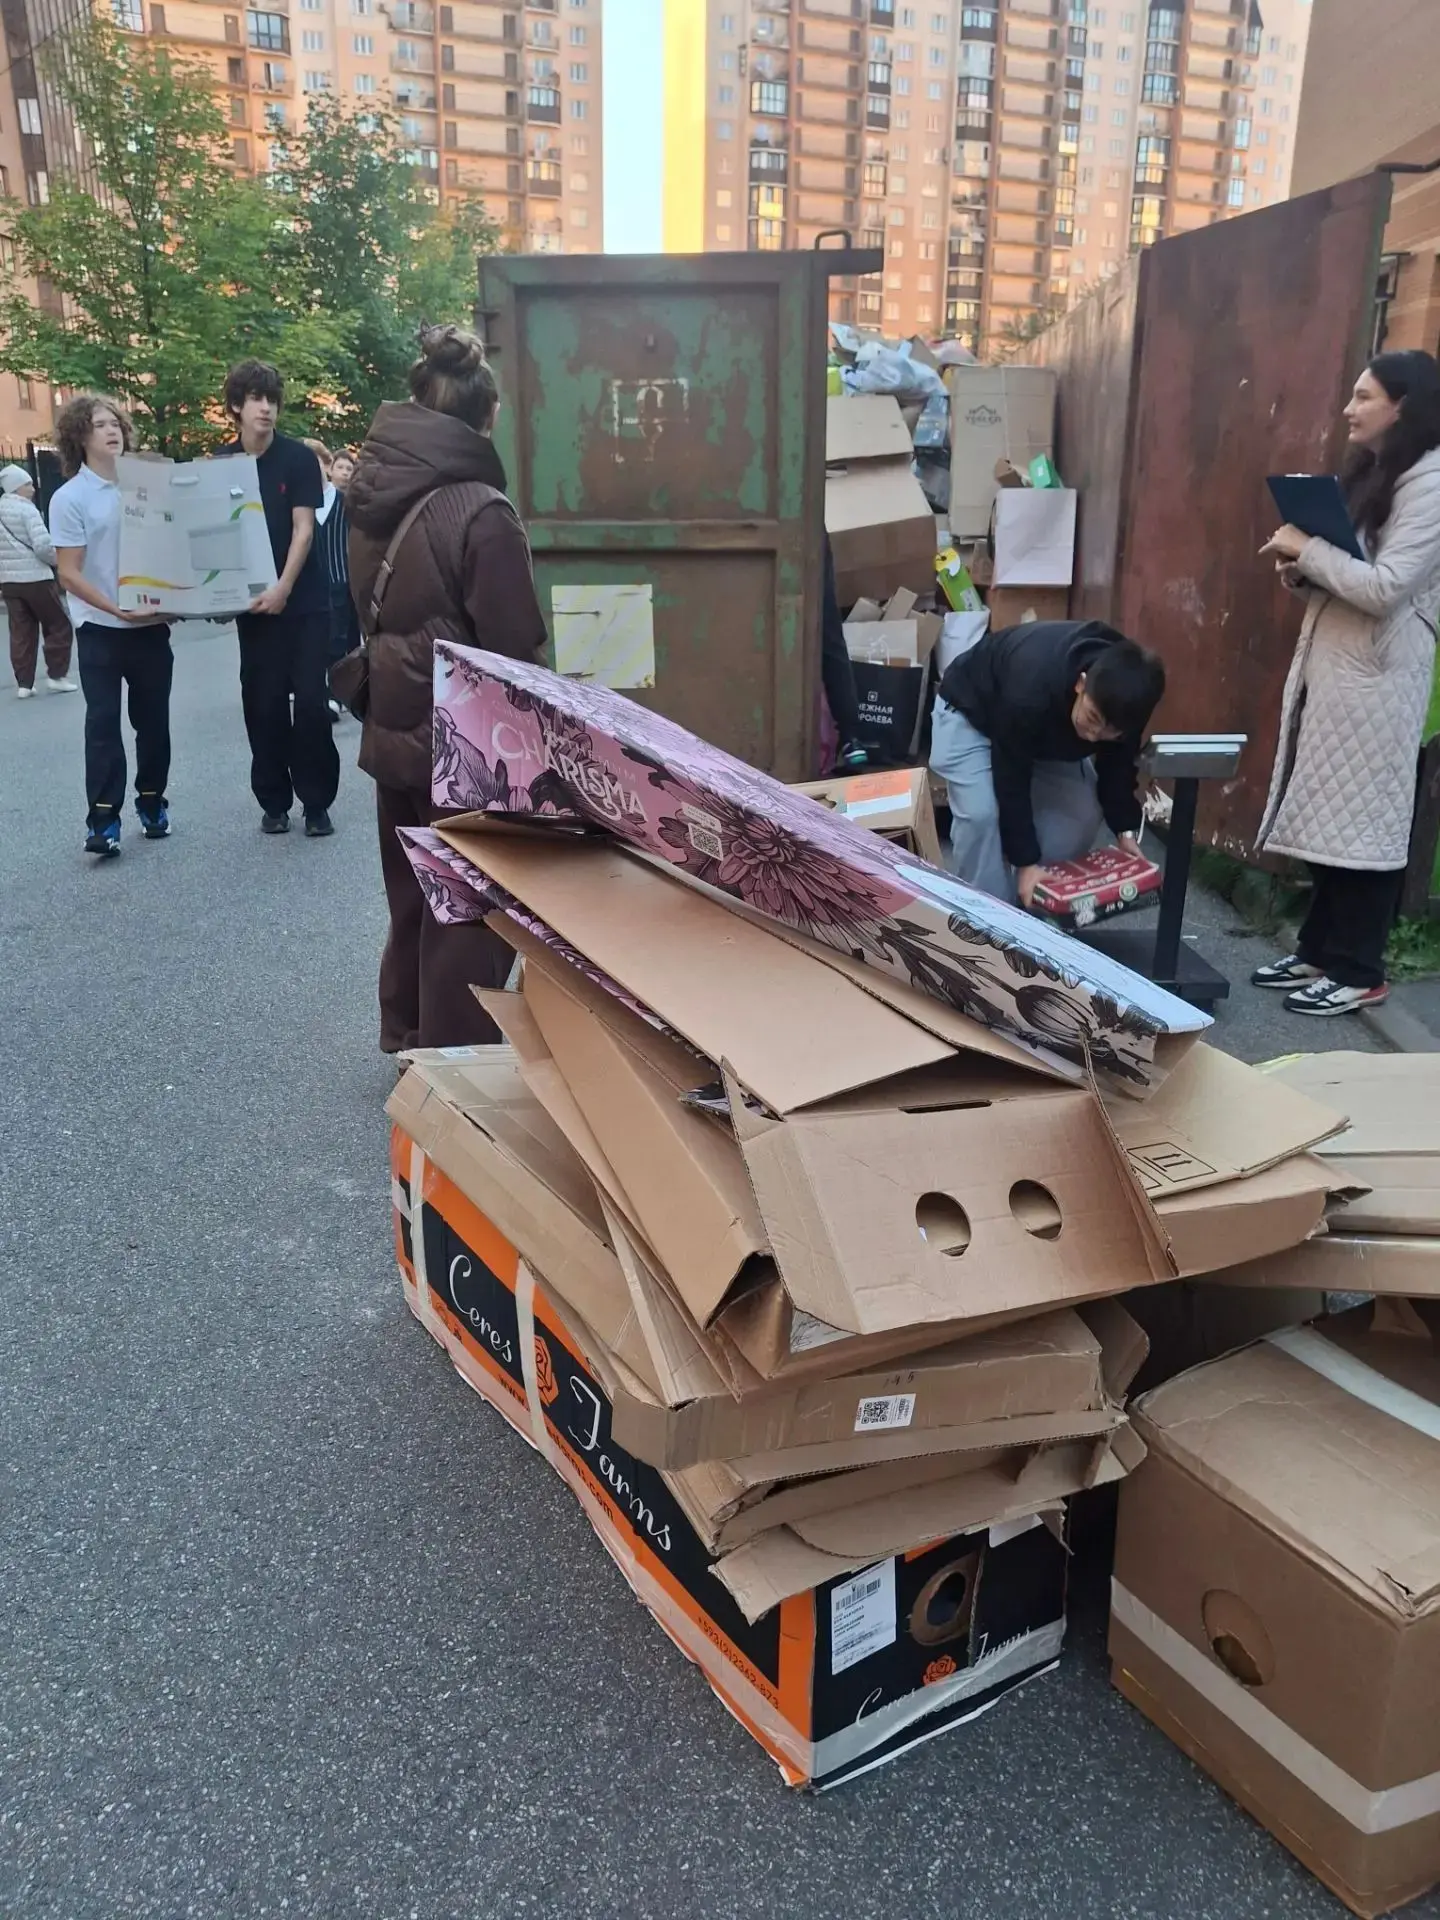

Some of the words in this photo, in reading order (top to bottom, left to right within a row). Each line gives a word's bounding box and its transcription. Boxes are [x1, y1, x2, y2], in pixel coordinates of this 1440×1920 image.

[858, 703, 893, 714] ЕЖНАЯ
[858, 713, 893, 725] РОЛЕВА
[491, 721, 648, 823] CHARISMA
[450, 1254, 513, 1363] Ceres
[568, 1375, 672, 1551] Farms
